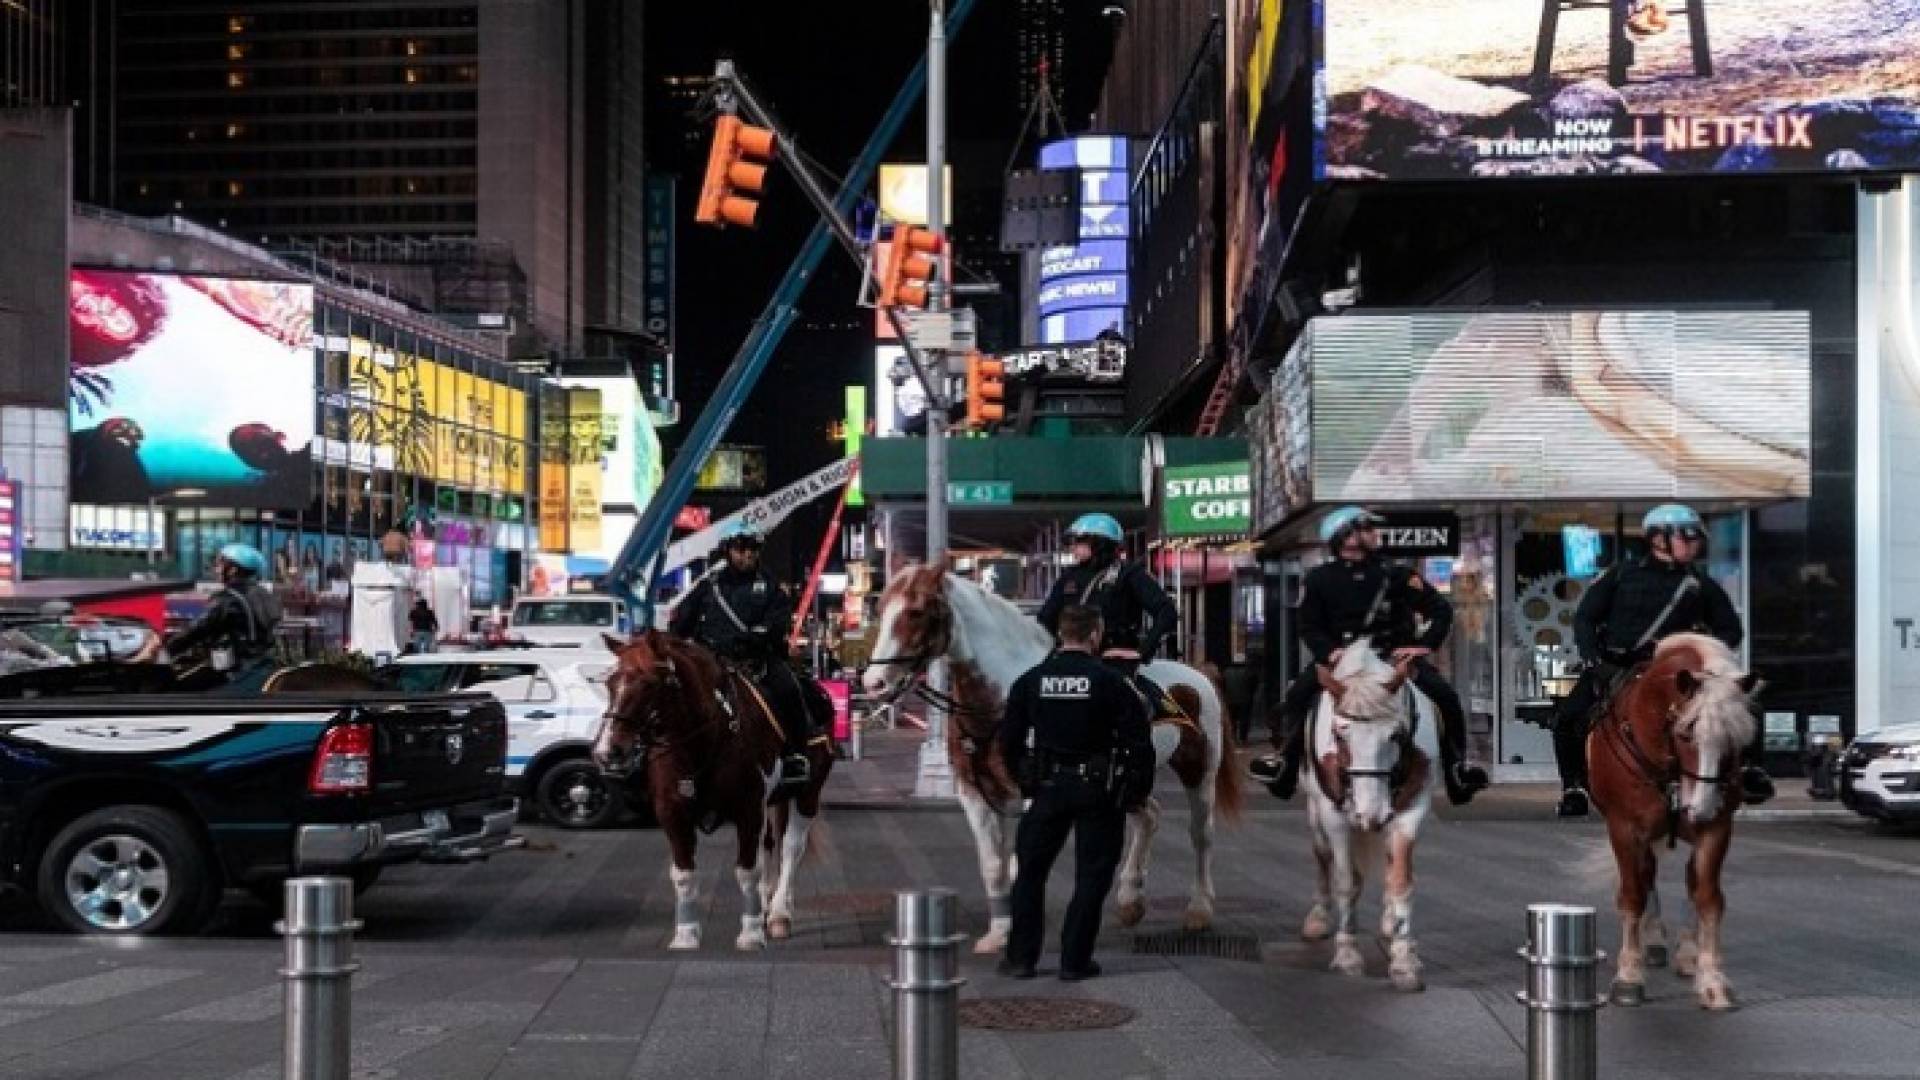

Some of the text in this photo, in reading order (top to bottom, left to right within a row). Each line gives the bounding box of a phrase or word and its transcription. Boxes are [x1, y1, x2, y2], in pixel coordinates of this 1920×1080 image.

[1555, 118, 1613, 136] NOW
[1663, 113, 1813, 152] NETFLIX
[1476, 138, 1613, 155] STREAMING
[1041, 677, 1089, 693] NYPD
